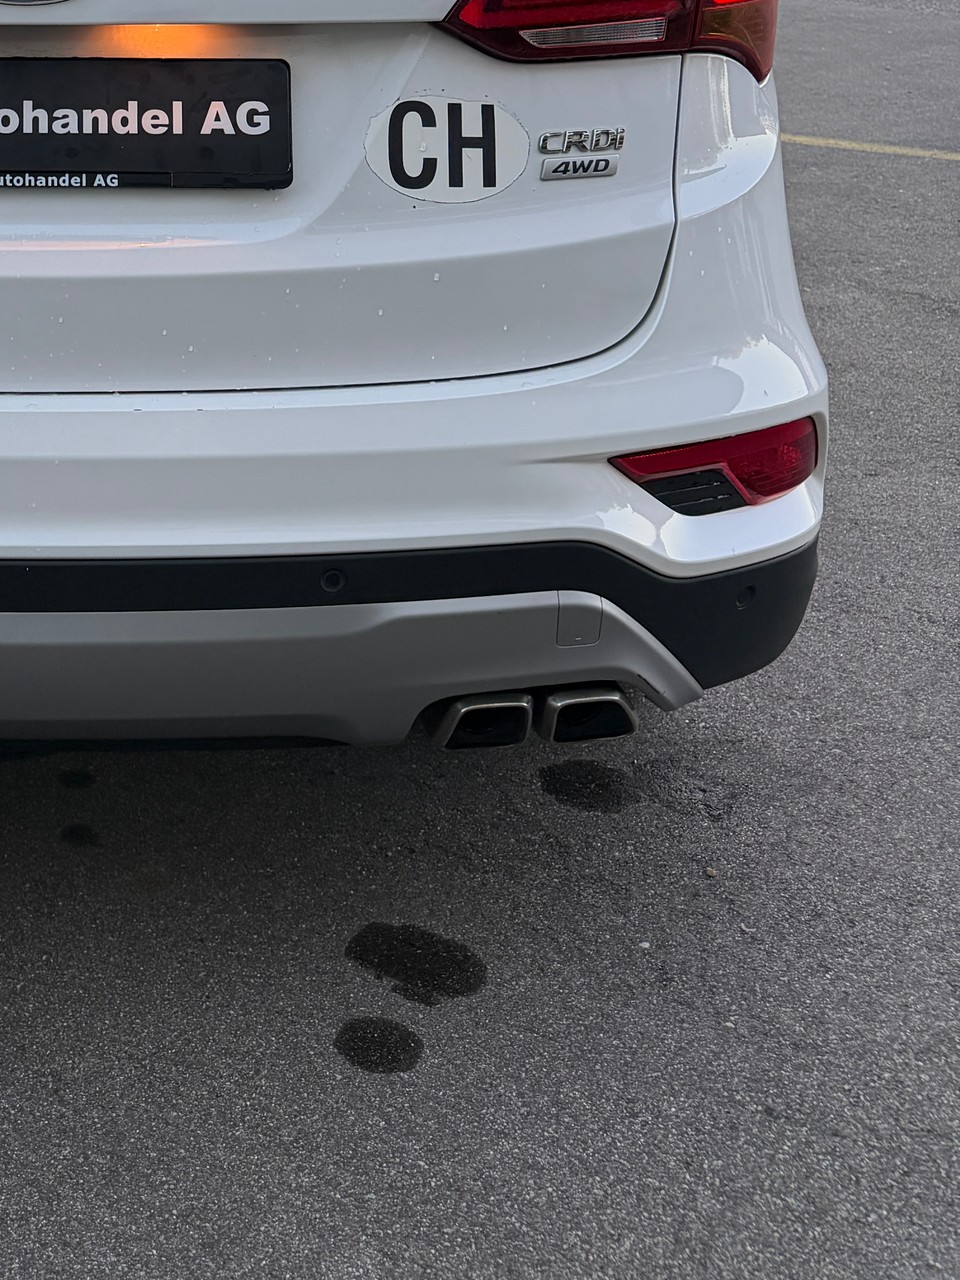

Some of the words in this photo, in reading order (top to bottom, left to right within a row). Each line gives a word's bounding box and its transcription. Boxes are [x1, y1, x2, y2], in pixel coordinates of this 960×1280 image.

[200, 101, 271, 135] AG
[388, 100, 497, 190] CH
[551, 158, 610, 175] 4WD
[93, 173, 119, 187] AG
